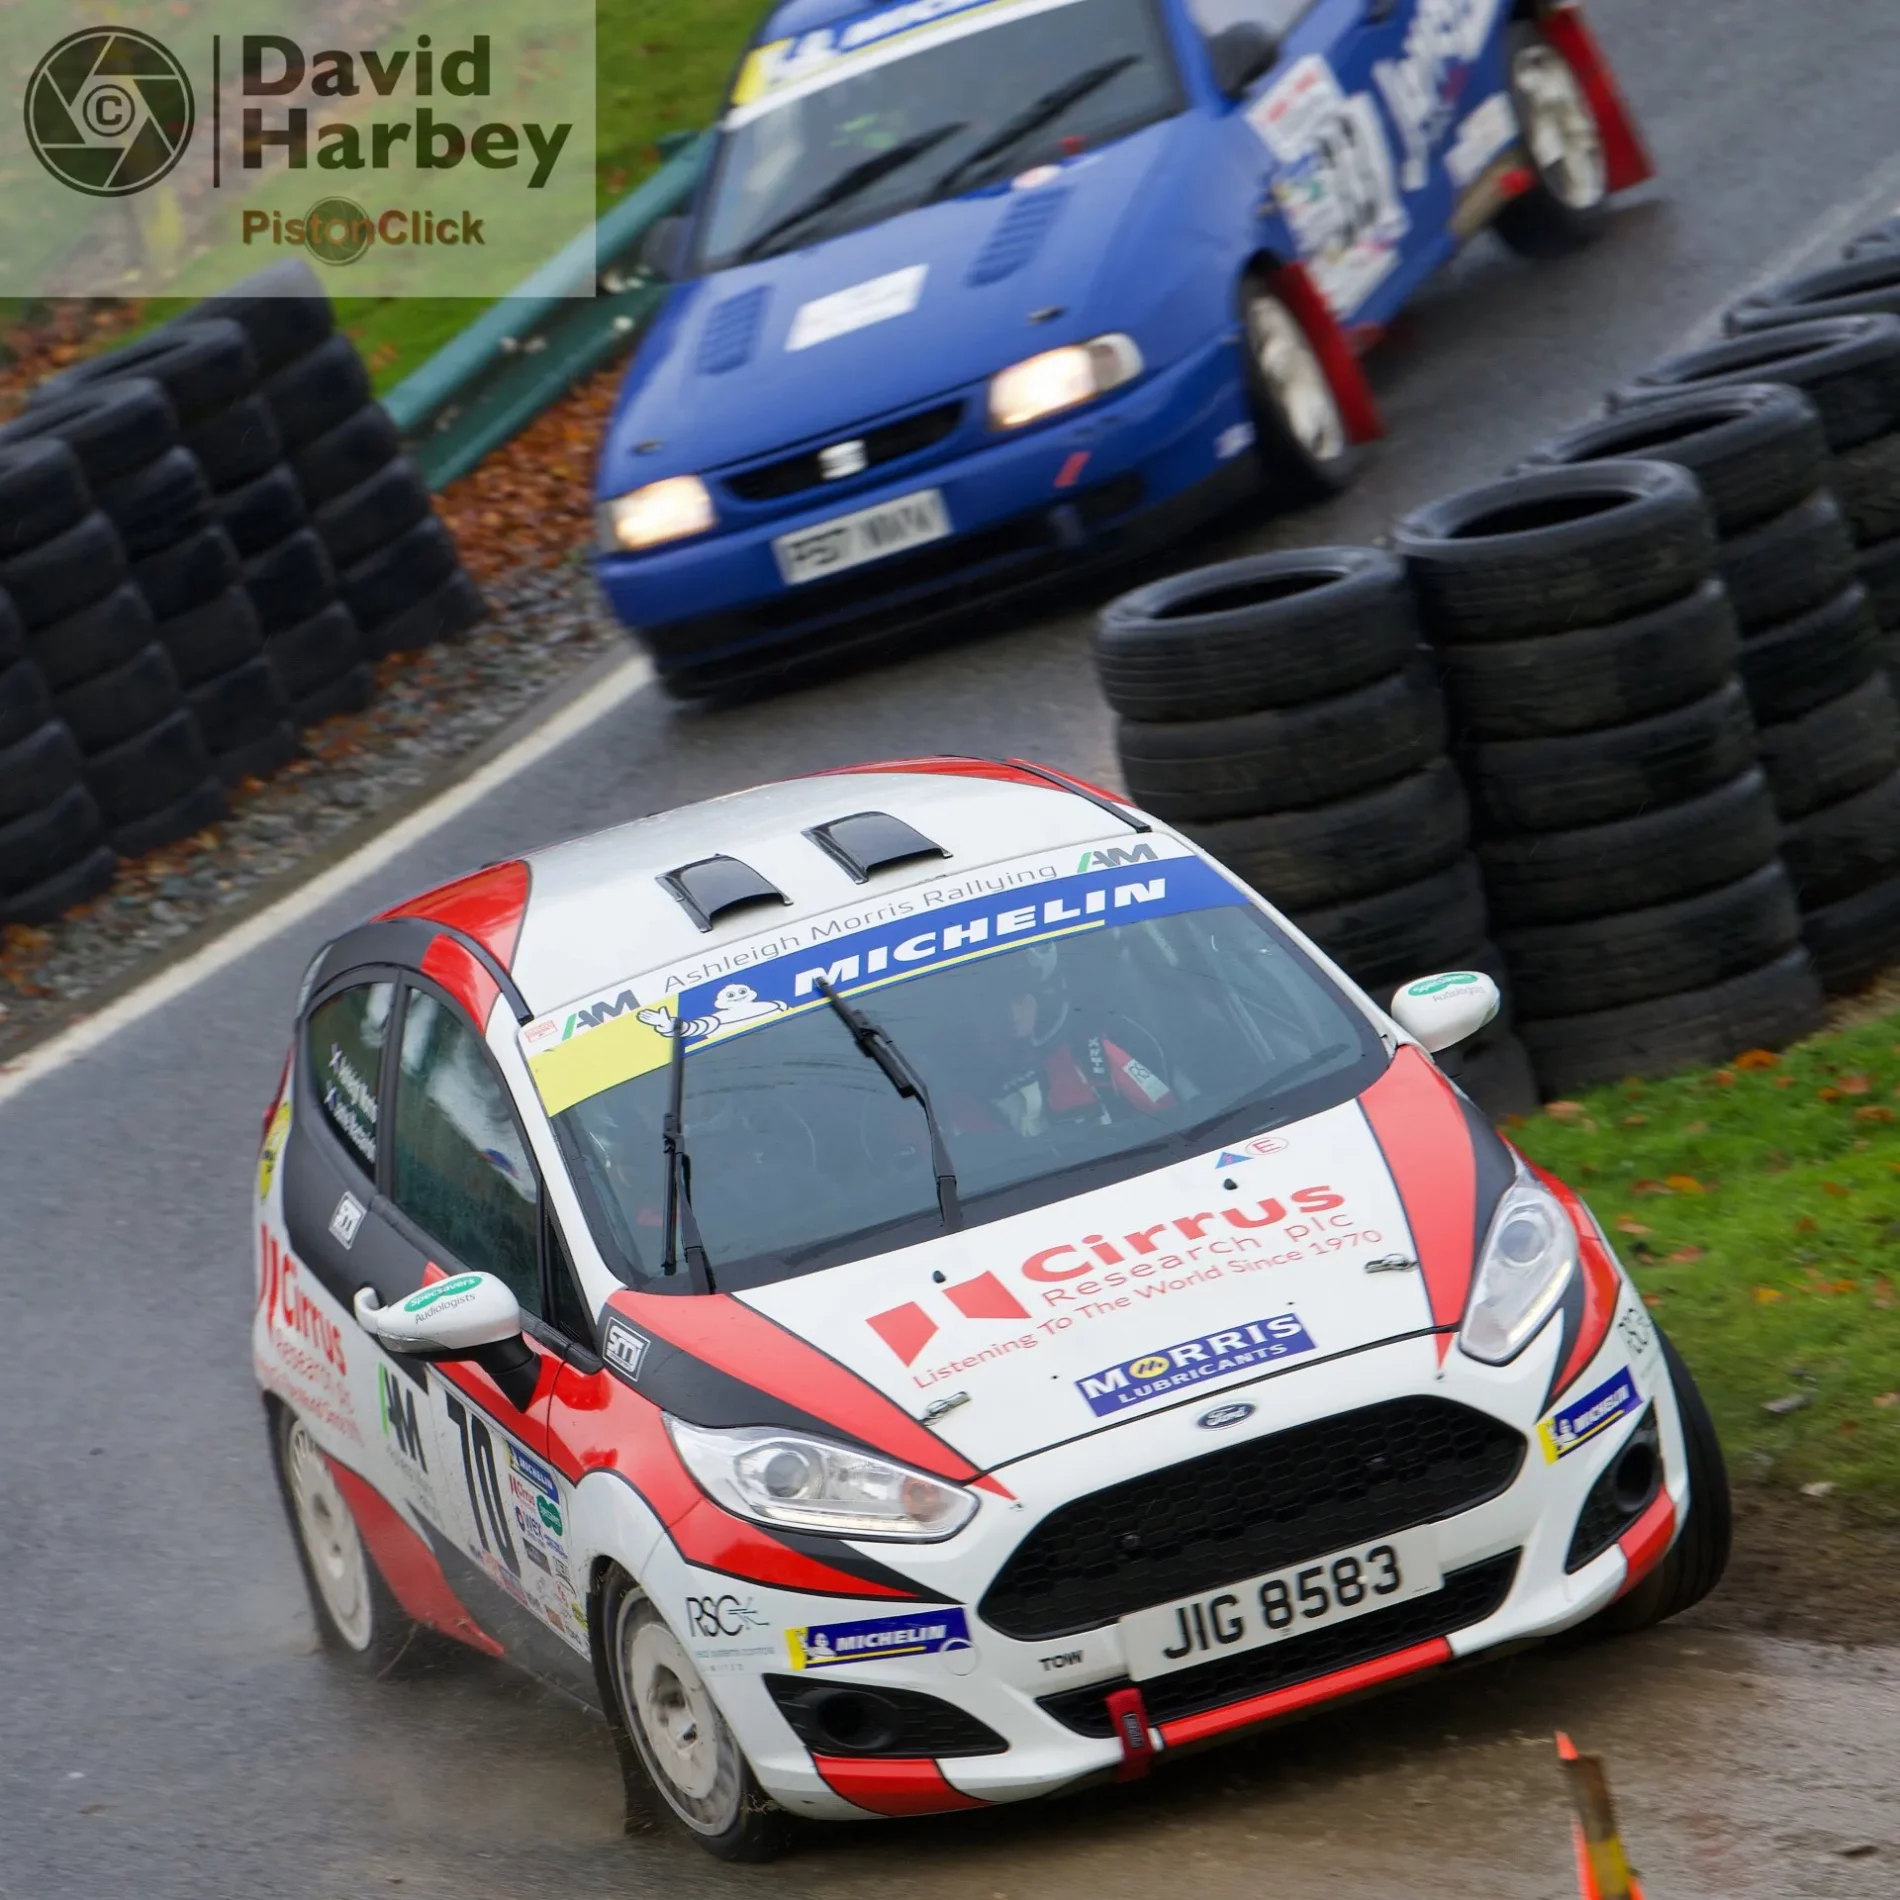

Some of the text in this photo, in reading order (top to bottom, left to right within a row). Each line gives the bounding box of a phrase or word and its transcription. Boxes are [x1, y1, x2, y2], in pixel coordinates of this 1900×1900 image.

[664, 864, 1058, 993] Ashleigh Morris Rallying
[794, 878, 1166, 998] MICHELIN
[1021, 1185, 1345, 1283] Cirrus
[1040, 1214, 1355, 1308] Research plc
[282, 1253, 347, 1377] Cirrus
[415, 1294, 476, 1325] Audiologists
[912, 1229, 1383, 1389] Listening To The World Since 1970
[1117, 1344, 1289, 1404] LUBRICANTS
[444, 1389, 522, 1578] 70
[835, 1624, 947, 1651] MICHELIN
[1163, 1544, 1402, 1660] JIG 8583
[1038, 1649, 1084, 1672] TOW
